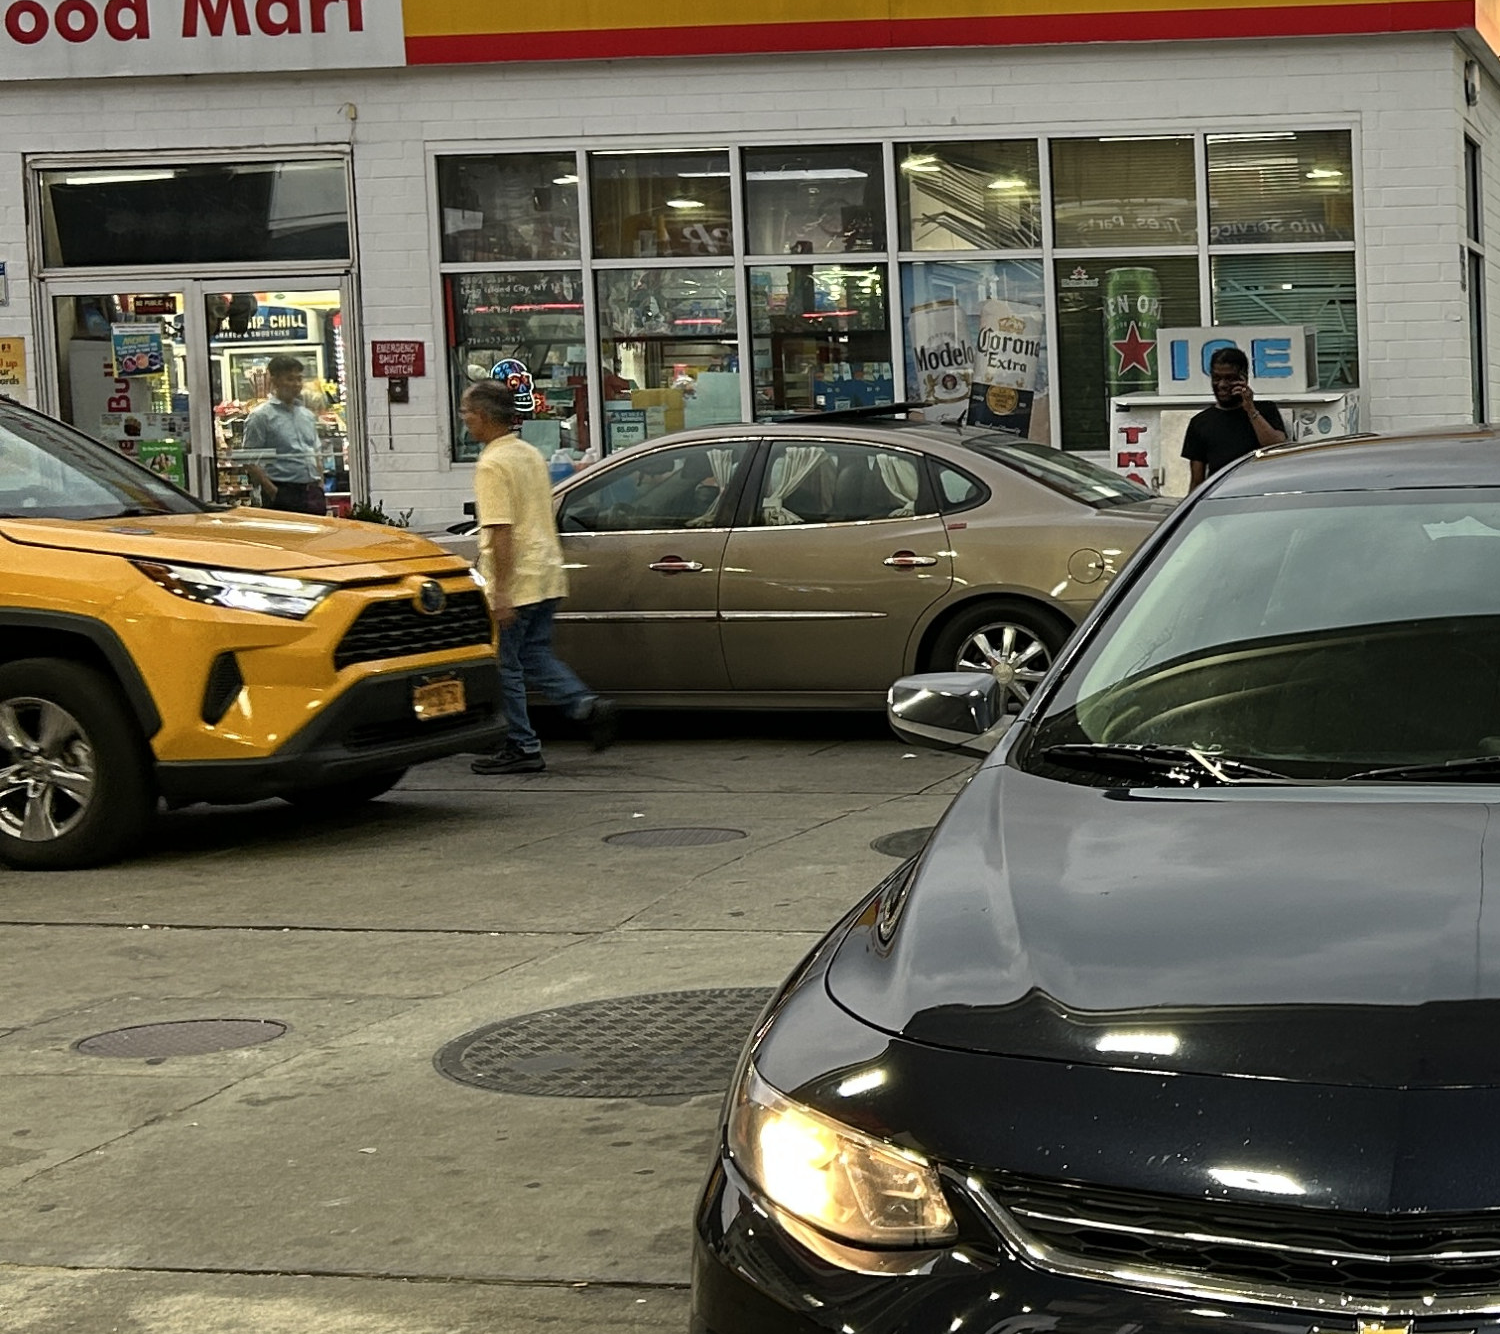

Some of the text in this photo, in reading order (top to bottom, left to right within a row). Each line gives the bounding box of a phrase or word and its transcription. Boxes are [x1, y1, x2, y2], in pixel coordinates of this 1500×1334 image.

[484, 284, 511, 294] Island
[534, 283, 547, 291] NY
[270, 314, 306, 328] CHILL
[376, 343, 419, 353] EMERGENCY
[379, 353, 416, 364] SHUT-OFF
[914, 340, 975, 372] Modelo
[1170, 338, 1293, 381] ICE
[987, 352, 1027, 373] Extra
[384, 365, 413, 375] SWITCH
